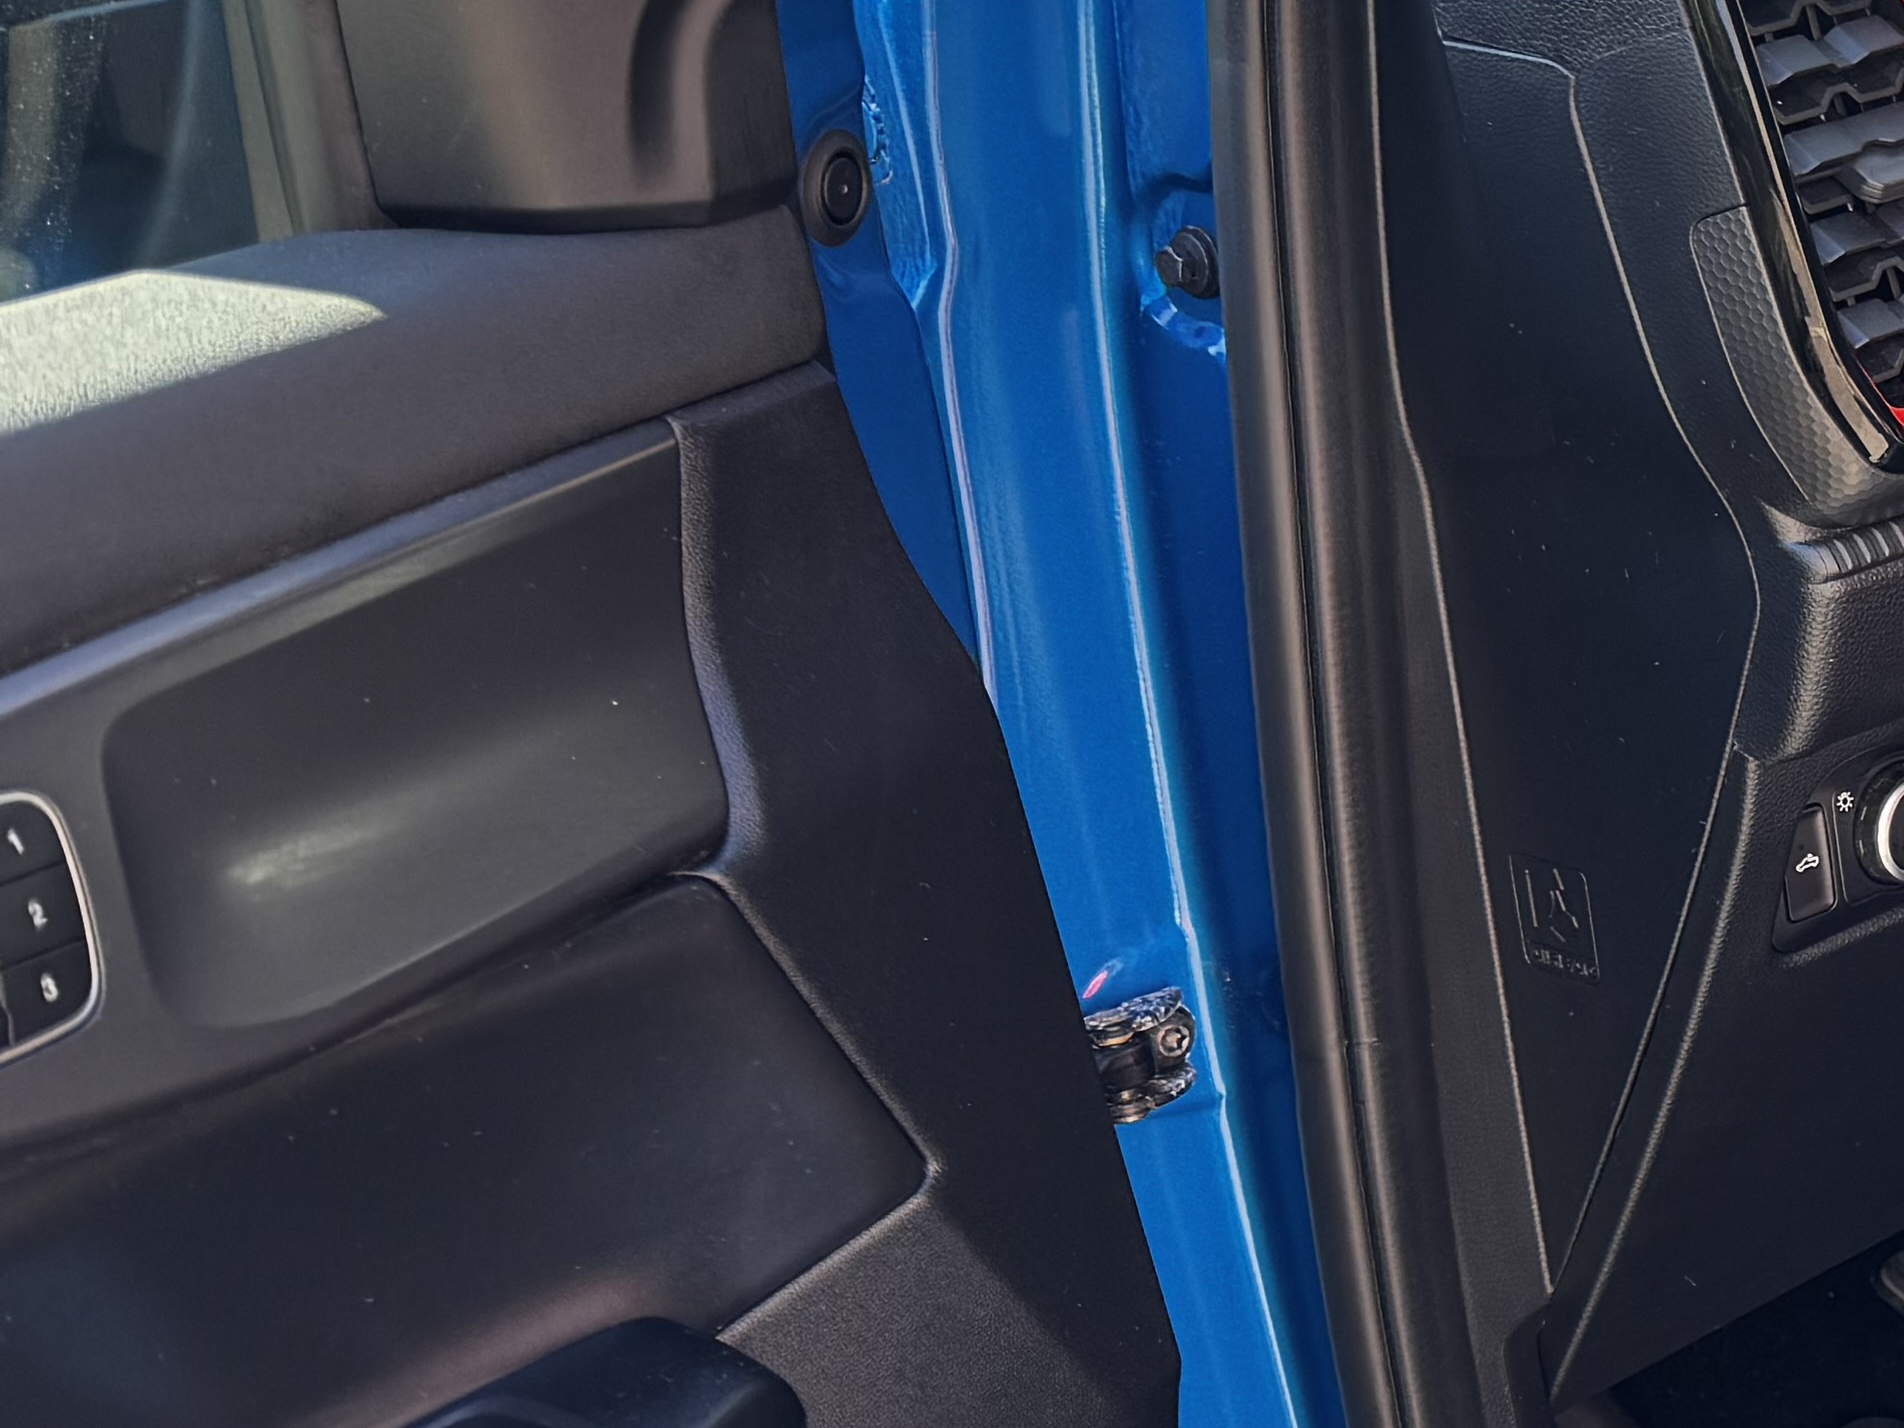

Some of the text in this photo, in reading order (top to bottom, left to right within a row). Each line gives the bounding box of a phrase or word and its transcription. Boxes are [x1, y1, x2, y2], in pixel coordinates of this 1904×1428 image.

[7, 827, 25, 856] 1
[28, 897, 49, 931] 2
[40, 971, 60, 1004] 3
